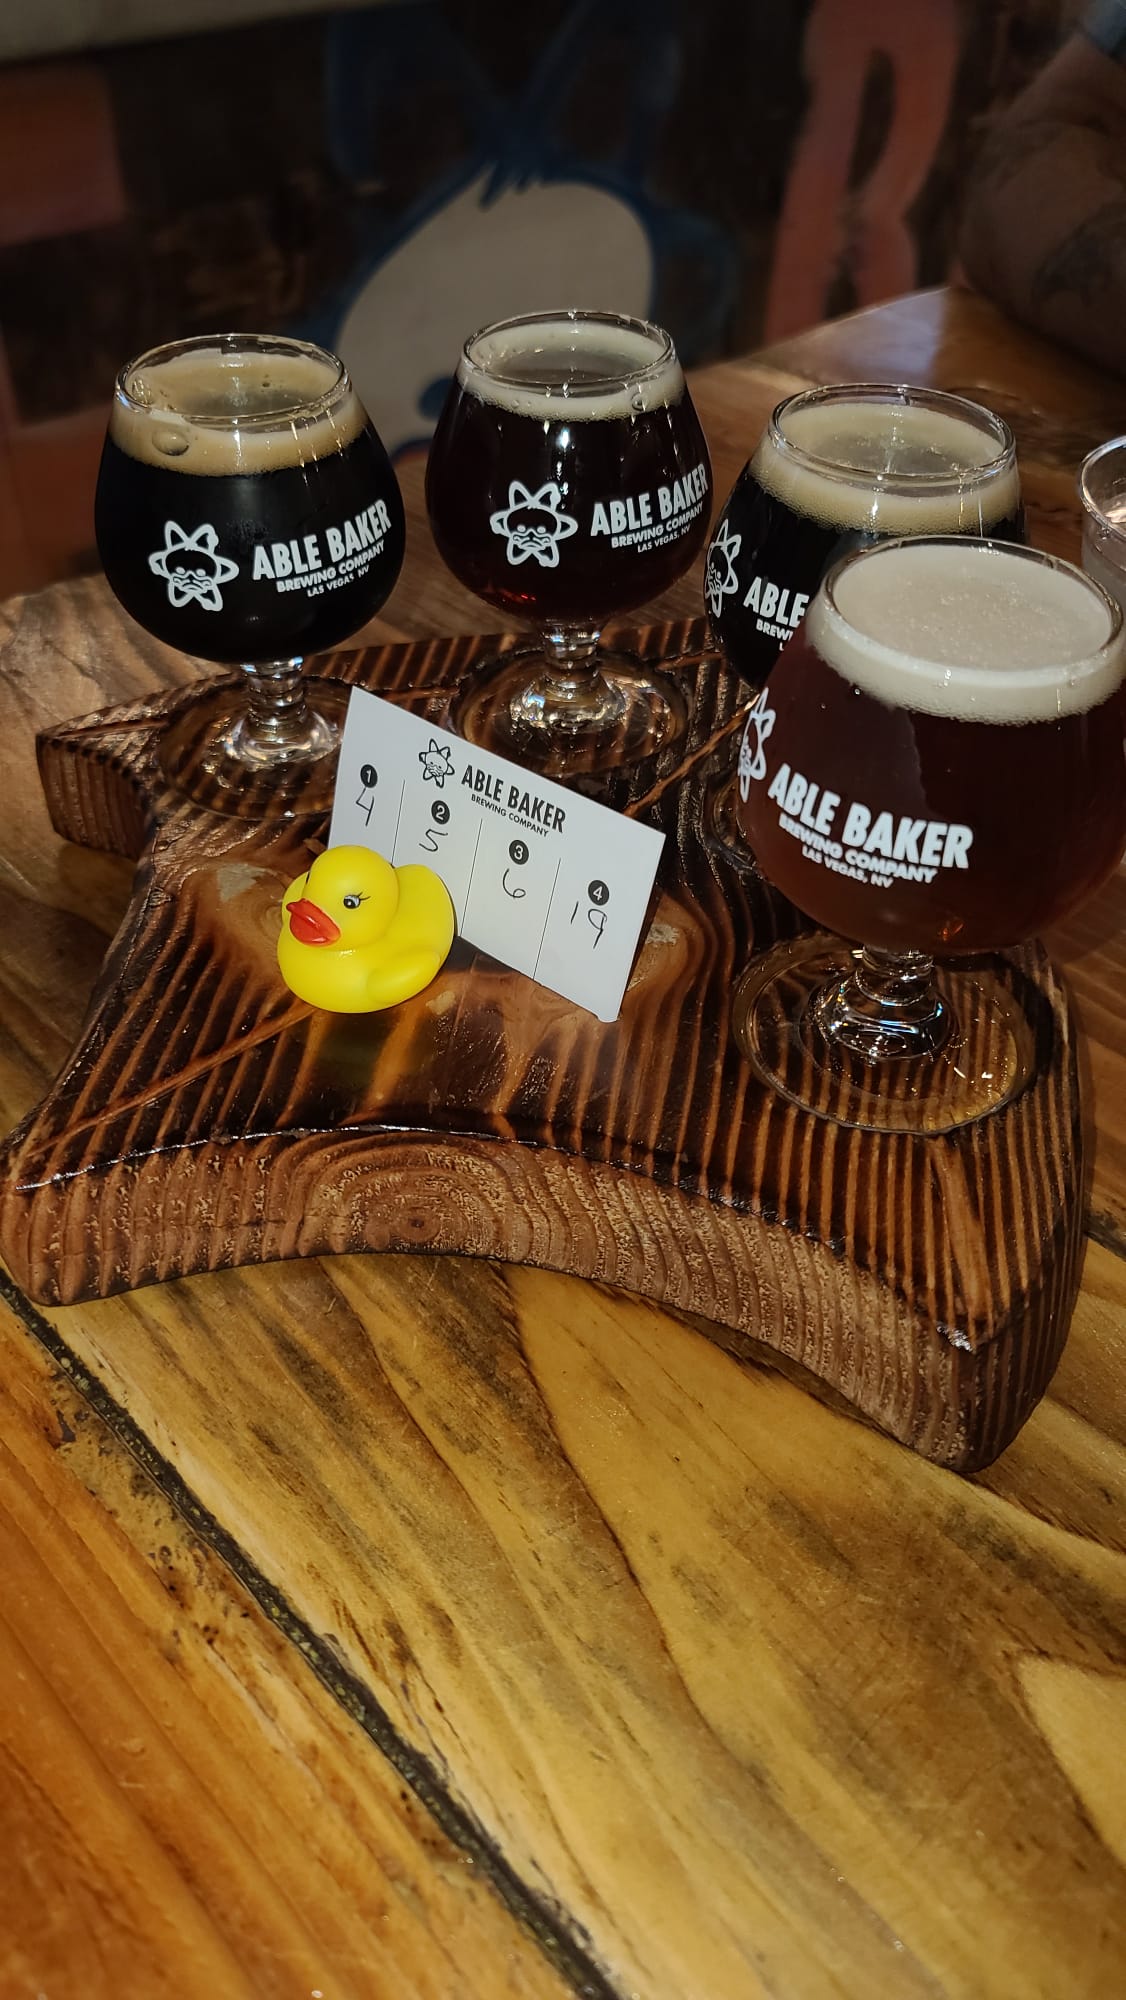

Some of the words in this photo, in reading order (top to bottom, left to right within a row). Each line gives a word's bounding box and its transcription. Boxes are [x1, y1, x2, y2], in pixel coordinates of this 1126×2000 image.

[591, 492, 653, 536] ABLE
[657, 463, 708, 520] BAKER
[252, 534, 322, 580] ABLE
[325, 499, 392, 563] BAKER
[611, 524, 664, 549] BREWING
[665, 501, 703, 532] COMPANY
[637, 543, 653, 553] LAS
[681, 523, 691, 535] NV
[276, 566, 337, 593] BREWING
[338, 540, 385, 575] COMPANY
[307, 586, 324, 597] LAS
[357, 564, 370, 578] NV
[743, 576, 810, 628] ABLE
[355, 787, 375, 826] 4
[461, 764, 504, 803] ABLE
[507, 785, 567, 834] BAKER
[471, 794, 507, 817] BREWING
[508, 812, 549, 837] COMPANY
[768, 763, 840, 836] ABLE
[841, 802, 973, 869] BAKER
[779, 813, 842, 859] BREWING
[845, 849, 937, 883] COMPANY
[802, 846, 822, 864] LAS
[824, 857, 868, 884] VEGAS,
[871, 873, 893, 888] NV
[502, 868, 526, 898] 6
